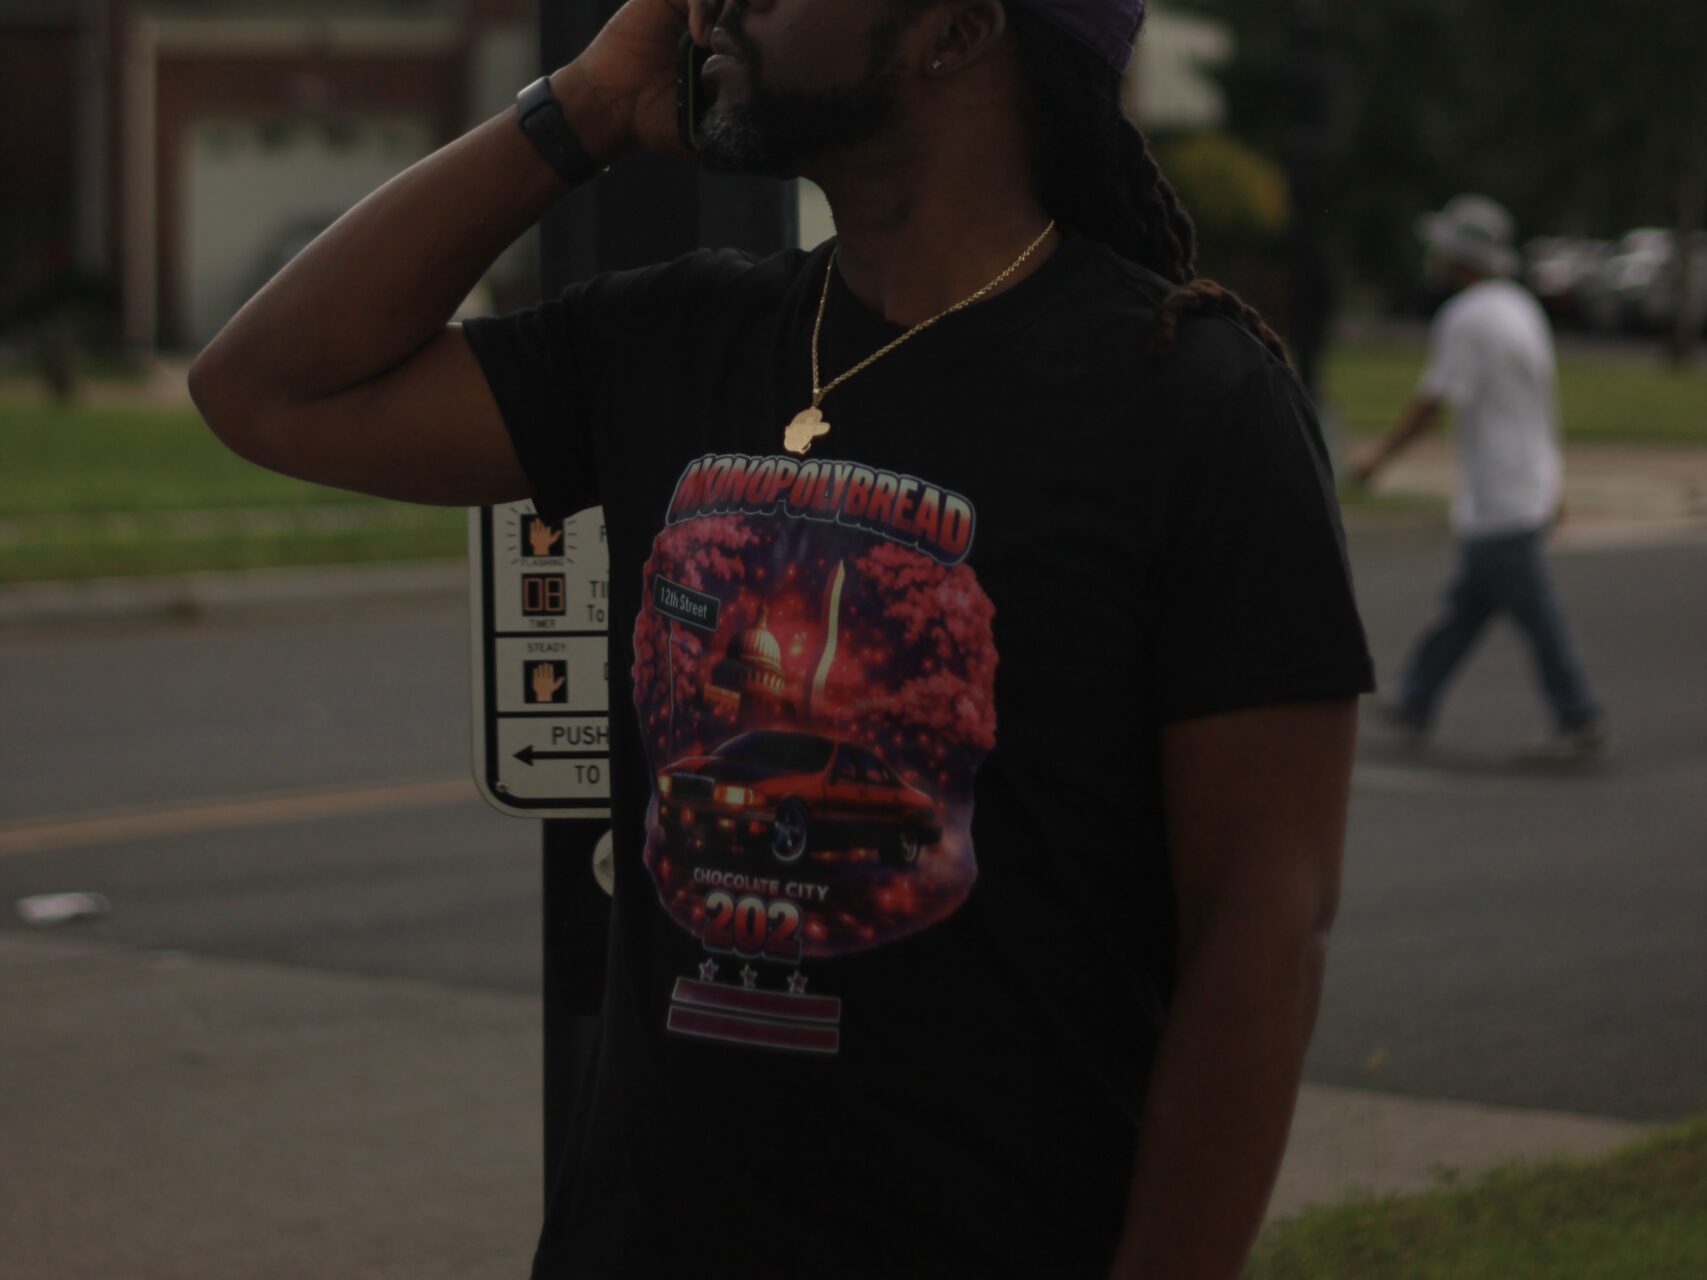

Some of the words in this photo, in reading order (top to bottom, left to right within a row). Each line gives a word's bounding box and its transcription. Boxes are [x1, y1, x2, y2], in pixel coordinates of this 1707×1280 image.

[670, 455, 973, 557] MONOPOLYBREAD
[660, 587, 678, 608] 12th
[680, 594, 707, 618] Street
[527, 643, 566, 653] STEADY
[574, 765, 600, 784] TO
[693, 867, 780, 896] CHOCOLATE
[785, 881, 829, 901] CITY
[704, 891, 801, 960] 202
